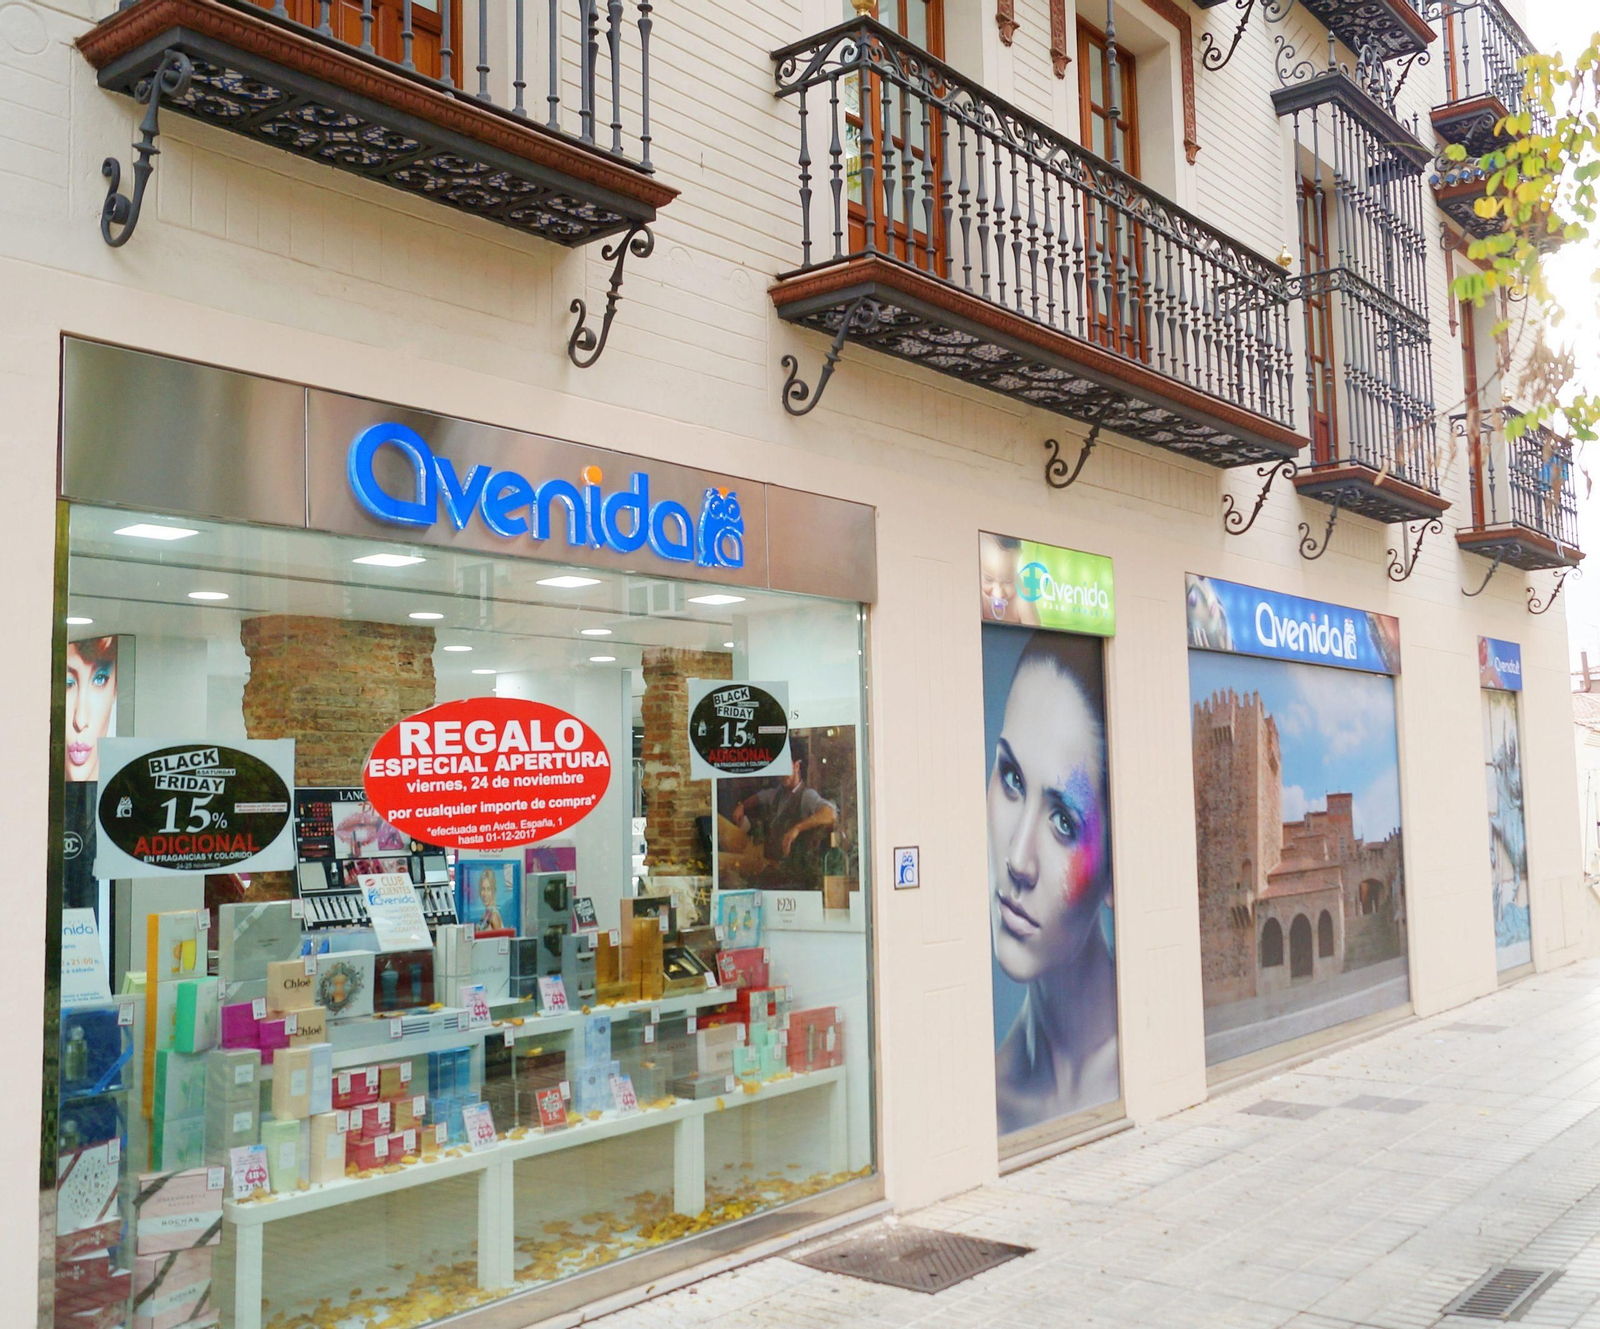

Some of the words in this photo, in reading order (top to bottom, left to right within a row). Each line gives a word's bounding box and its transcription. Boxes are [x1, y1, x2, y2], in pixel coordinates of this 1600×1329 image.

[714, 688, 748, 705] BLACK
[717, 706, 753, 718] FRIDAY
[400, 719, 584, 756] REGALO
[150, 750, 217, 773] BLACK
[708, 748, 773, 763] ADICIONAL
[369, 756, 488, 777] ESPECIAL
[494, 751, 609, 771] APERTURA
[157, 775, 223, 792] FRIDAY
[407, 777, 467, 793] viernes,
[471, 776, 488, 790] 24
[492, 775, 509, 788] de
[513, 772, 584, 787] noviembre
[388, 807, 411, 822] por
[415, 802, 477, 818] cualquier
[480, 799, 528, 815] importe
[531, 798, 545, 810] de
[480, 824, 491, 832] en
[493, 820, 518, 832] Avda.
[520, 818, 556, 831] España,
[557, 817, 563, 827] 1
[133, 833, 260, 857] ADICIONAL
[458, 834, 484, 845] hasta
[485, 830, 536, 842] 01-12-2017
[144, 855, 155, 863] EN
[156, 853, 206, 862] FRAGANCIAS
[214, 852, 252, 860] COLORIDO
[380, 876, 404, 886] CLUB
[284, 978, 311, 990] Chloé
[161, 1217, 200, 1226] ROCHAS
